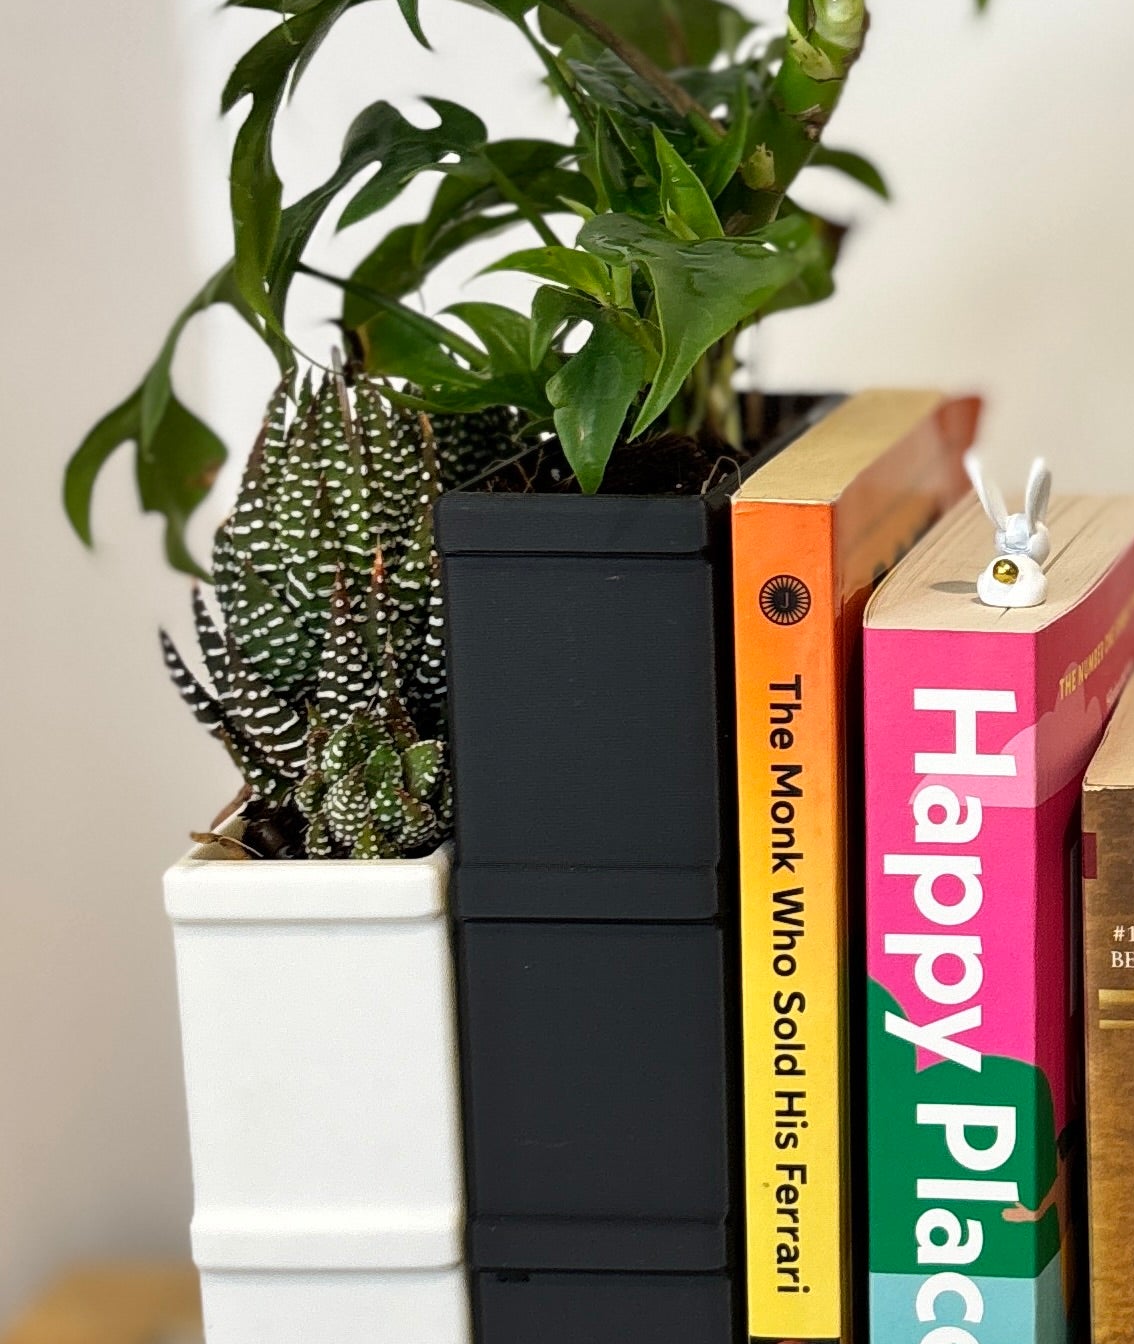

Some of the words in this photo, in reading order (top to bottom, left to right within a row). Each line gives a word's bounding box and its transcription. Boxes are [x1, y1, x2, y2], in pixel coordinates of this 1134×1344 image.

[768, 673, 803, 750] The
[1059, 670, 1077, 700] THE
[769, 765, 805, 875] Monk
[883, 687, 1018, 1073] Happy
[771, 886, 806, 977] Who
[772, 991, 807, 1077] Sold
[774, 1090, 809, 1151] His
[775, 1163, 811, 1295] Ferrari
